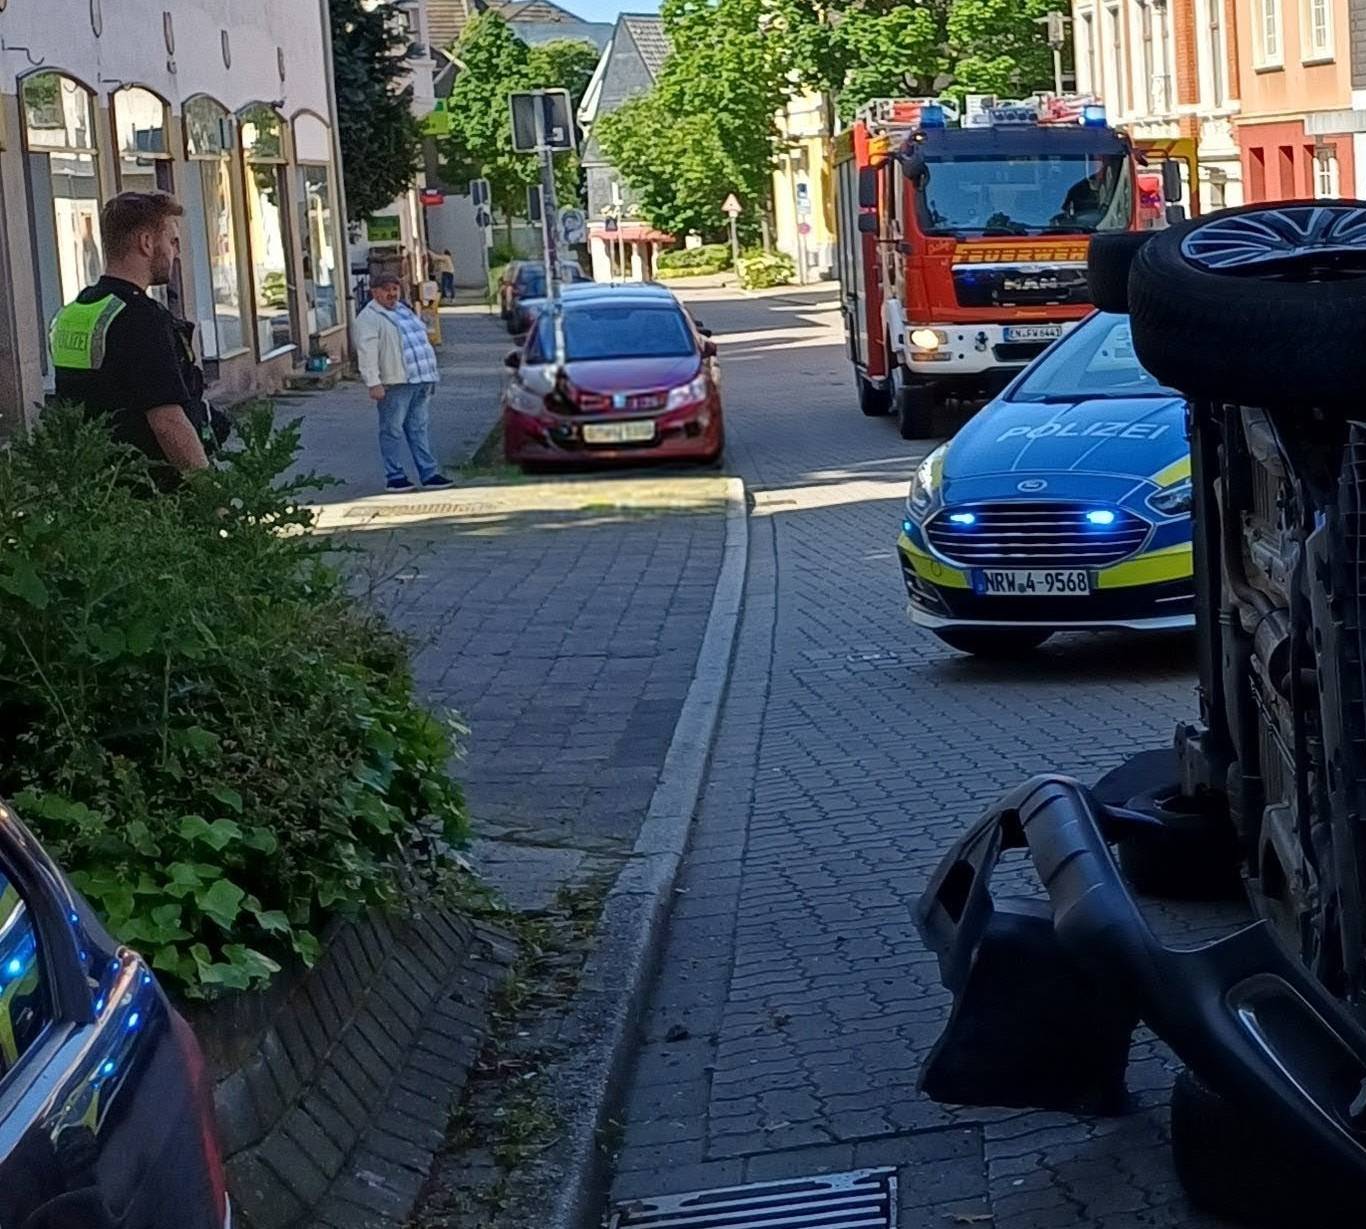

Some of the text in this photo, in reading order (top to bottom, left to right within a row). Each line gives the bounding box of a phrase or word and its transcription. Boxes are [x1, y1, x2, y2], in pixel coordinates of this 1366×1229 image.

[952, 246, 1087, 263] FEUERWEH
[1004, 278, 1057, 290] MAN
[996, 421, 1171, 443] POLIZEI
[984, 571, 1087, 592] NRW 4-9568
